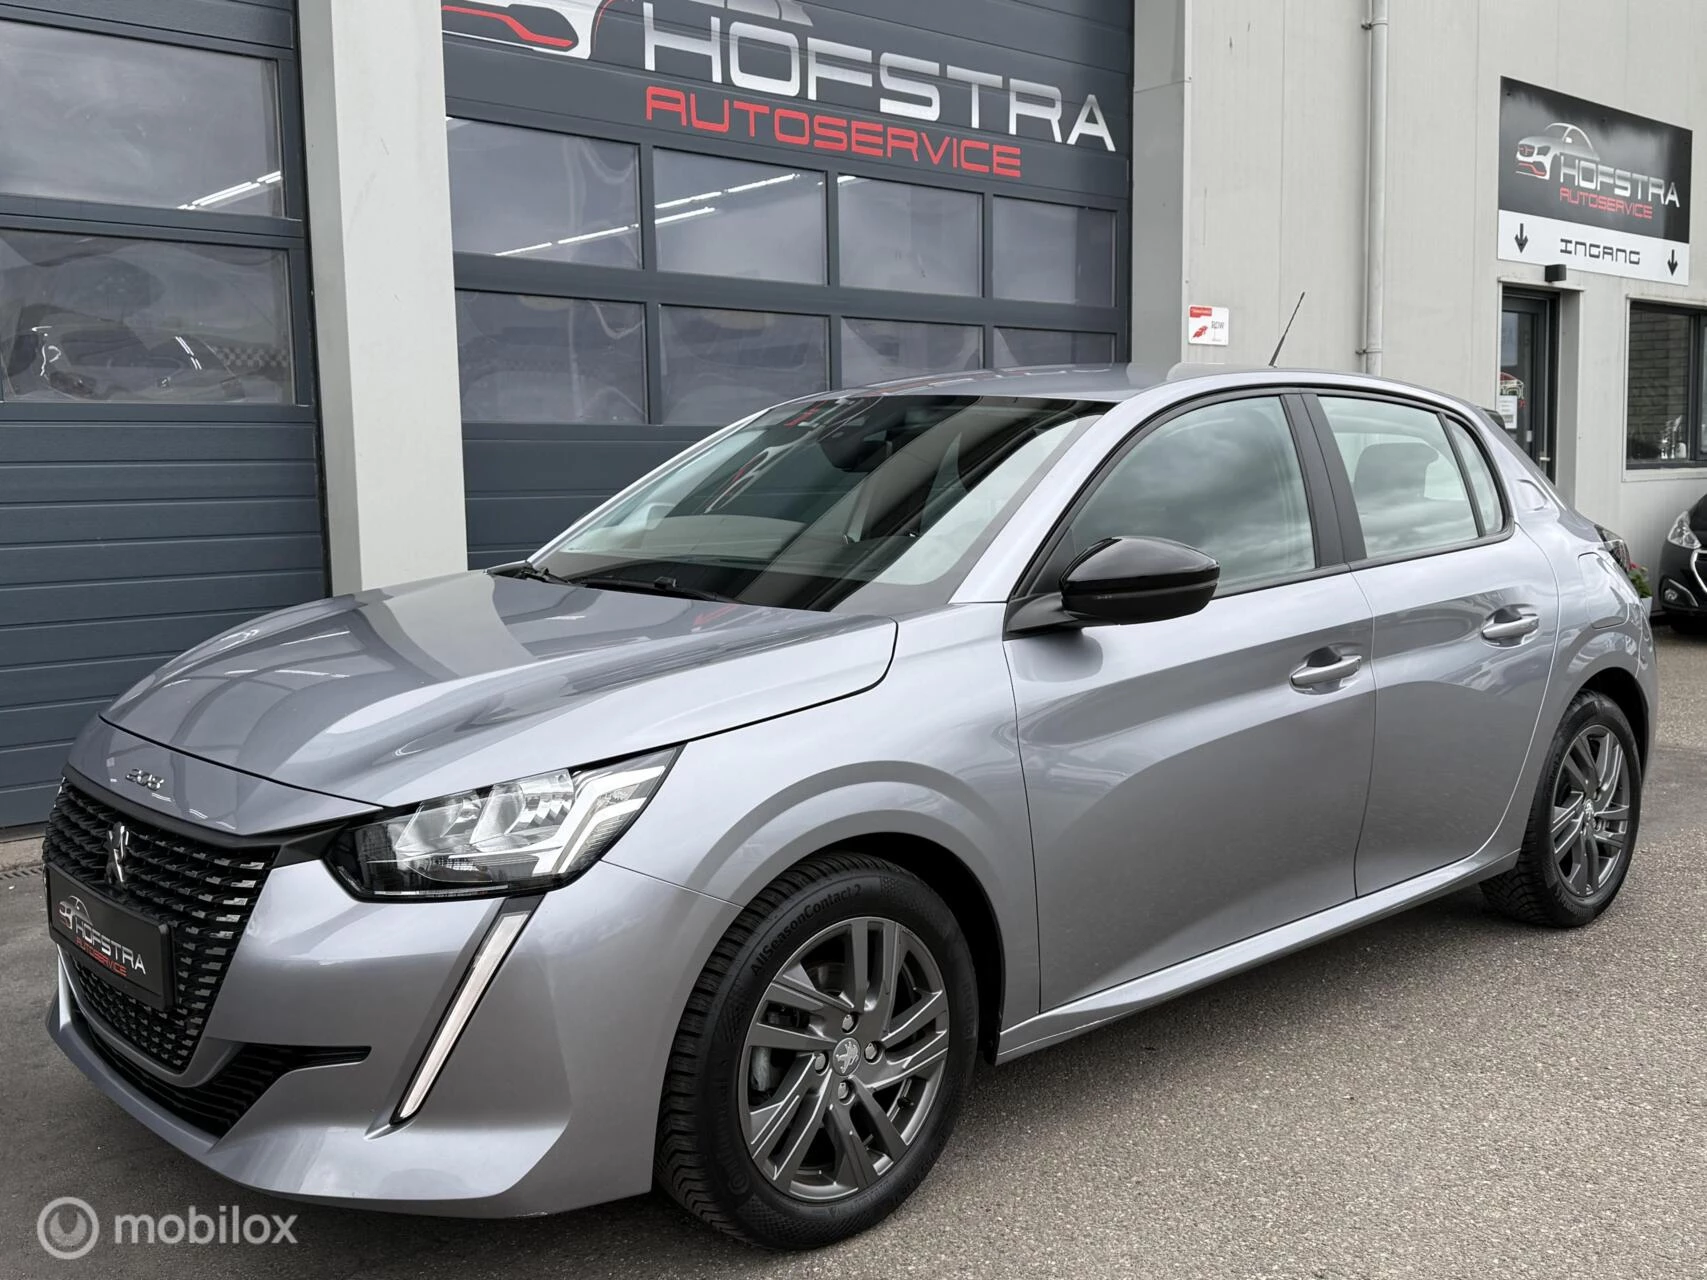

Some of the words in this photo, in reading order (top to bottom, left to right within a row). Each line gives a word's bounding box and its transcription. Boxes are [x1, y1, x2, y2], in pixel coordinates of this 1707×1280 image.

[644, 2, 1116, 152] HOFSTRA
[645, 86, 1021, 178] AUTOSERVICE
[1560, 155, 1680, 208] HOFSTRA
[1560, 187, 1653, 219] AUTOSERVICE
[1560, 238, 1641, 265] INGANG
[75, 920, 146, 975] HOFSTRA
[75, 936, 128, 977] AUTOSERVICE
[751, 885, 852, 976] AllSeasonContact
[854, 883, 862, 897] 2
